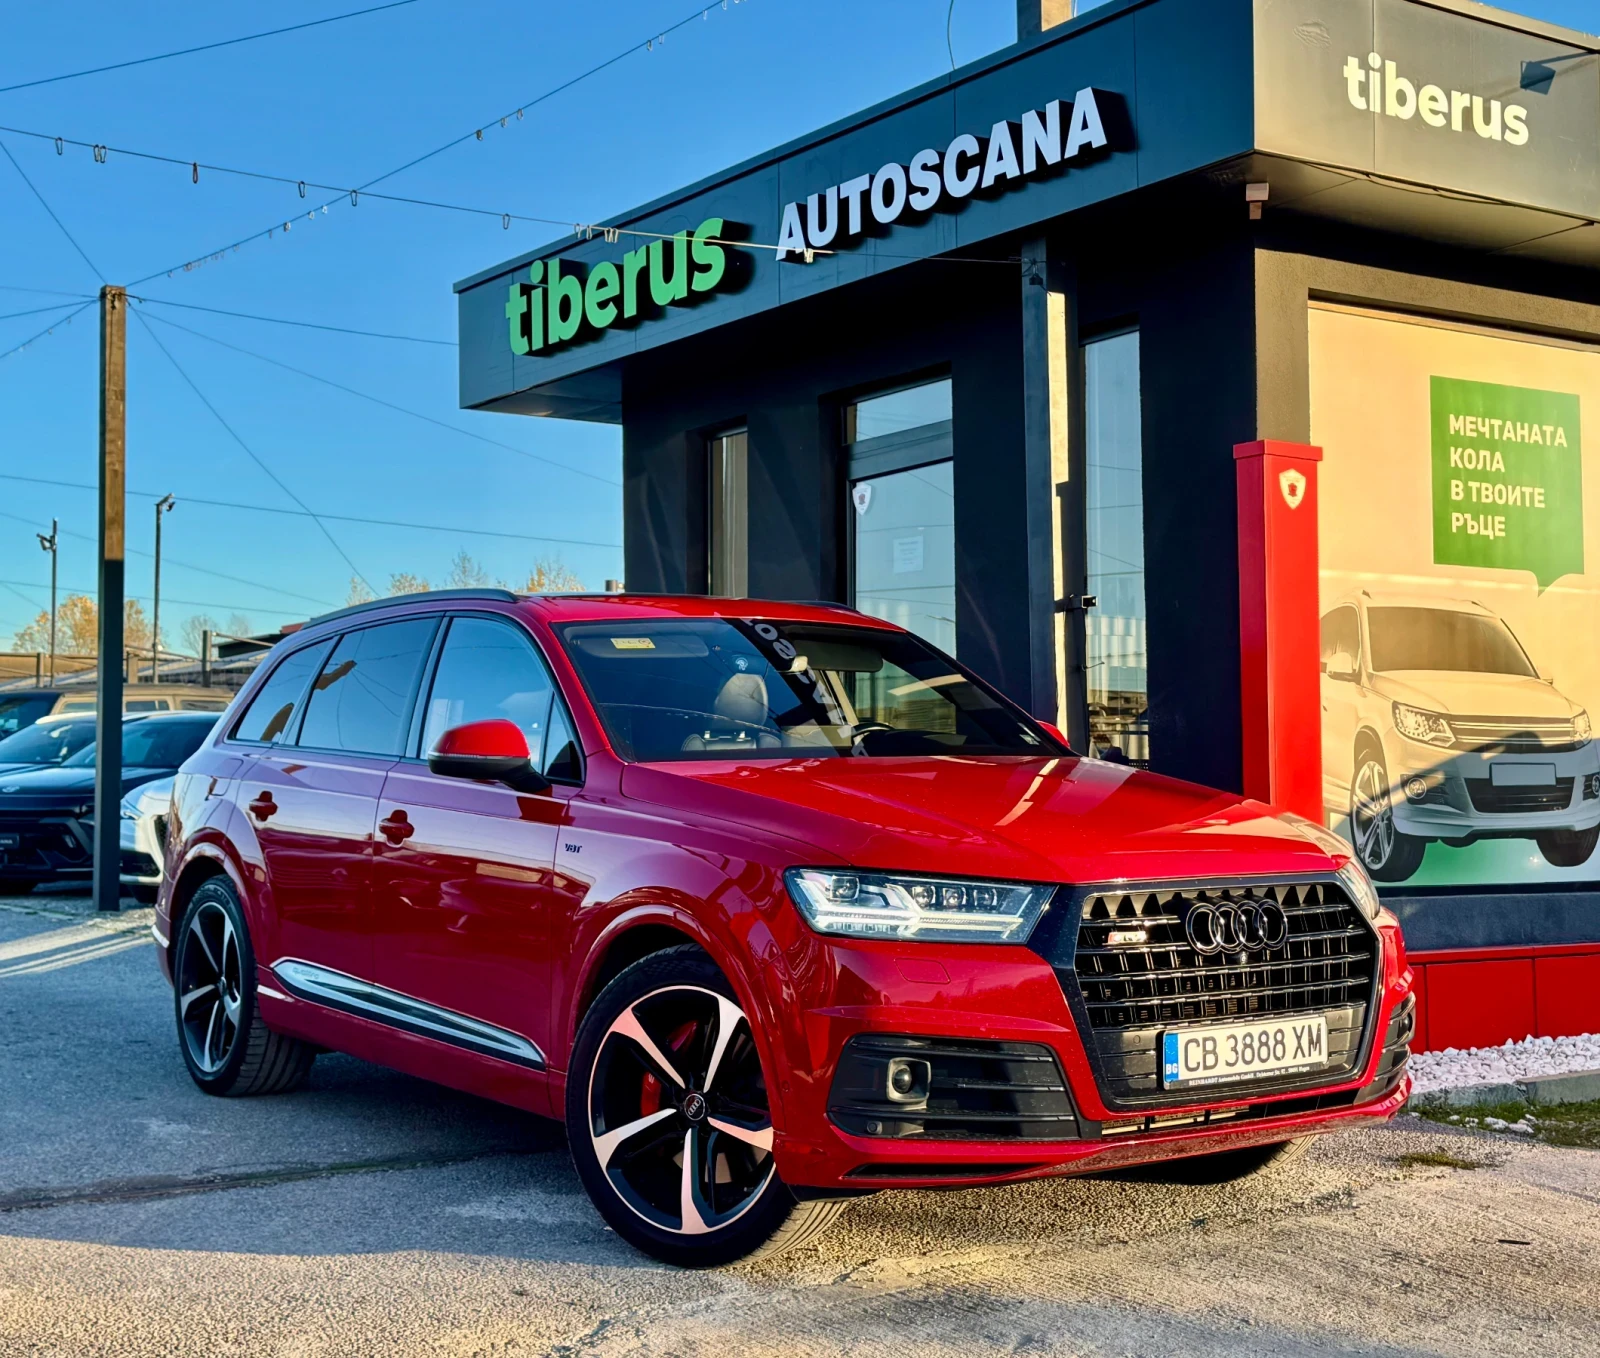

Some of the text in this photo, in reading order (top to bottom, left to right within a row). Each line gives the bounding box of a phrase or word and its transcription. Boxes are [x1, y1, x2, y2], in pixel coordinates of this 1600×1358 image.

[1343, 52, 1529, 146] tiberus
[775, 86, 1108, 262] AUTOSCANA
[505, 218, 726, 356] tiberus
[1449, 413, 1567, 448] МЕЧТАНАТА
[1449, 446, 1505, 473] КОЛА
[1450, 479, 1545, 509] В ТВОИТЕ
[1451, 512, 1506, 539] РЪЦЕ
[1184, 1023, 1322, 1072] CB 3888 XM
[1166, 1062, 1178, 1074] BG
